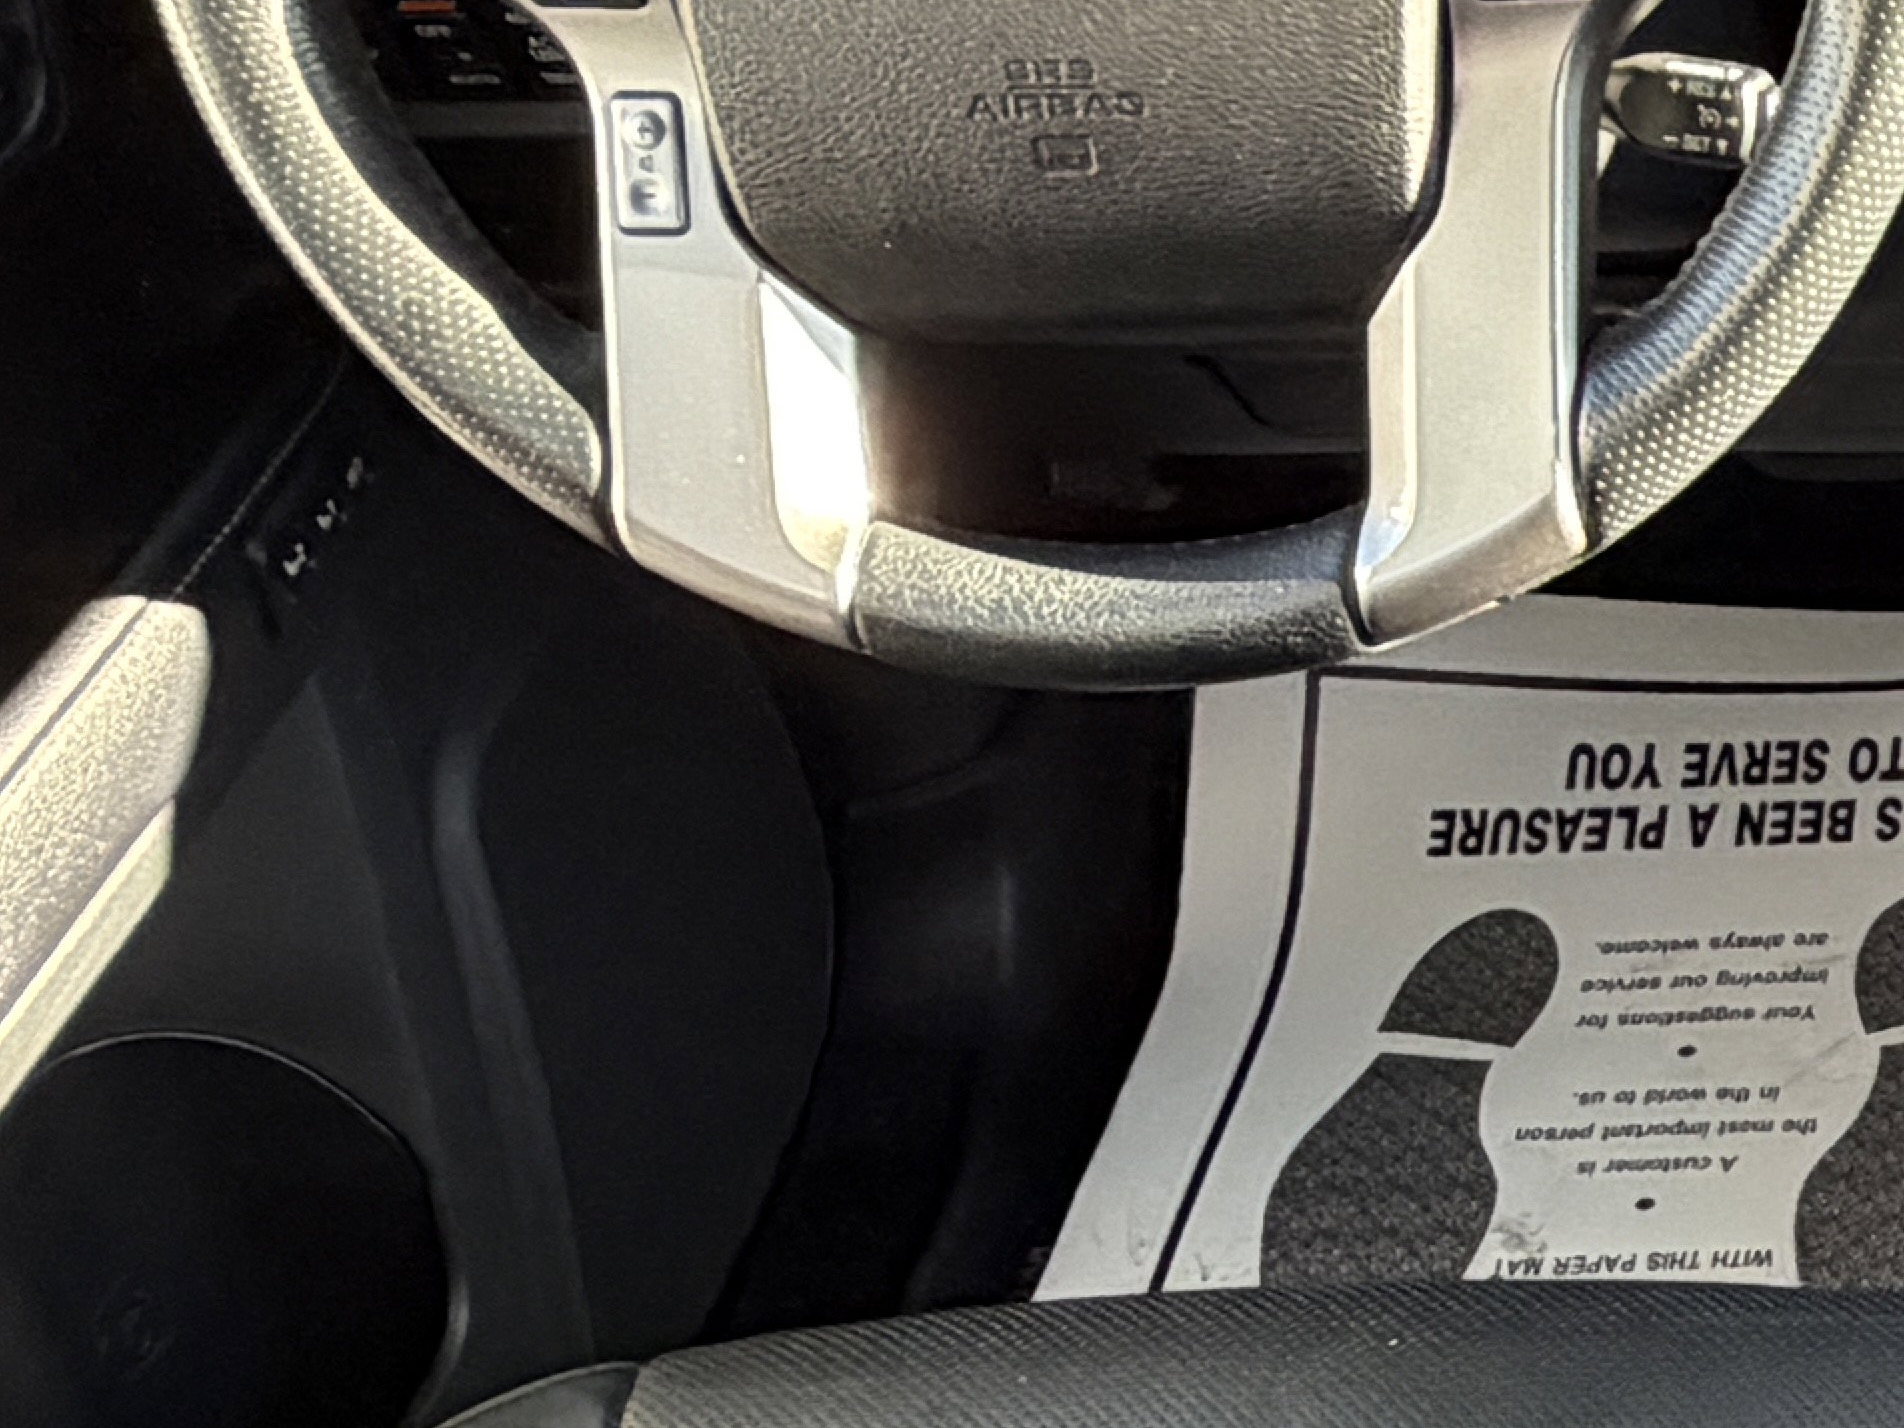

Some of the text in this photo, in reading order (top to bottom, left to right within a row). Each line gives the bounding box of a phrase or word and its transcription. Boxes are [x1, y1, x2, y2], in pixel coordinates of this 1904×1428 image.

[966, 90, 1147, 123] AIRBAG
[1564, 742, 1663, 791] YOU
[1681, 739, 1830, 787] SERVE
[1426, 804, 1669, 857] PLEASURE
[1688, 802, 1720, 849] A
[1734, 799, 1856, 847] BEEN
[1709, 931, 1785, 952] always
[1793, 932, 1829, 946] are
[1580, 966, 1829, 993] improving our service
[1574, 1004, 1815, 1030] Your suggestions for
[1613, 1089, 1637, 1105] to
[1644, 1086, 1707, 1106] world
[1716, 1085, 1750, 1103] the
[1759, 1085, 1780, 1102] in
[1514, 1117, 1818, 1142] the most important person
[1577, 1154, 1740, 1177] A customer is
[1553, 1252, 1637, 1276] PAPER
[1646, 1250, 1700, 1273] THIS
[1711, 1248, 1773, 1271] WITH
